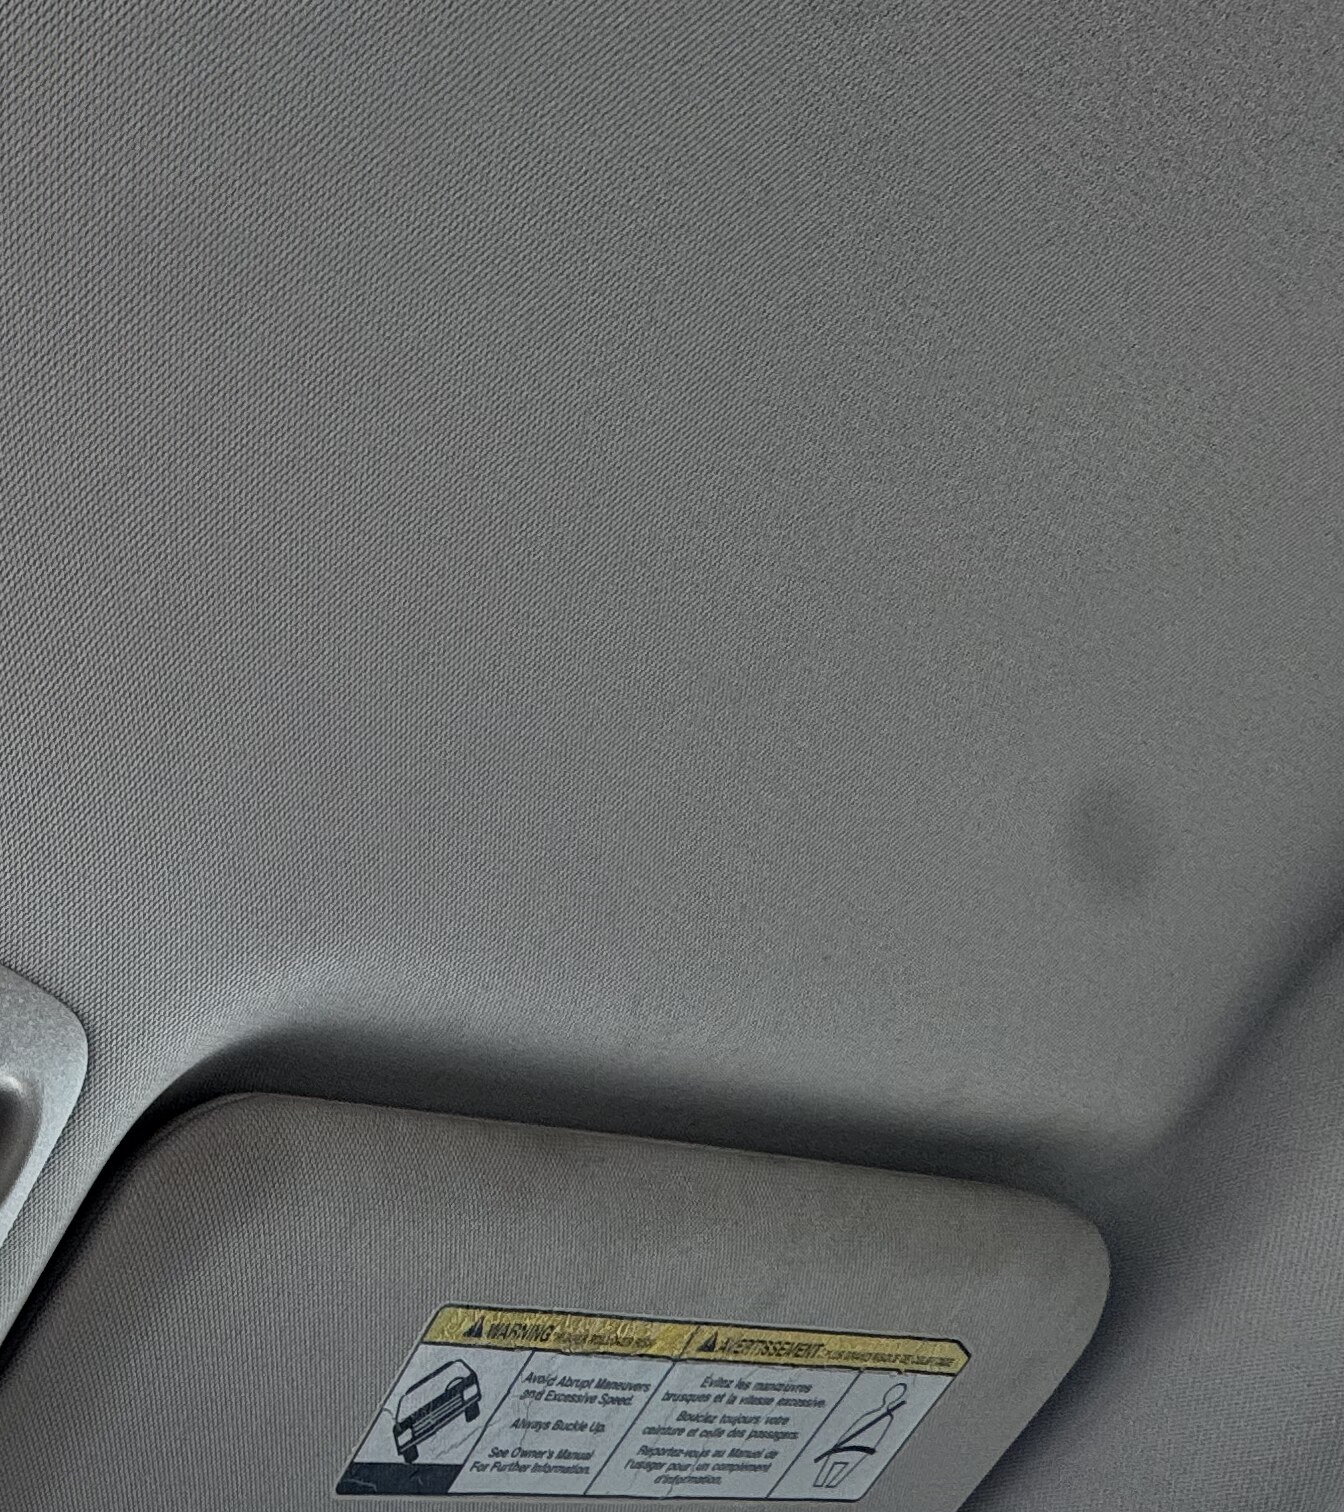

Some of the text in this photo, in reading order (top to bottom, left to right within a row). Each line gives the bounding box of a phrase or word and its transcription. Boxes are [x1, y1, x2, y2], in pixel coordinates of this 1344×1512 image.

[524, 1372, 652, 1392] Avoid Abrupt Maneuvers
[519, 1388, 545, 1401] and
[545, 1390, 598, 1404] Excessive
[510, 1418, 550, 1433] Always
[551, 1419, 589, 1432] Buckle
[488, 1446, 509, 1459] See
[554, 1449, 595, 1461] Manual
[469, 1460, 490, 1473] For
[491, 1461, 530, 1474] Further
